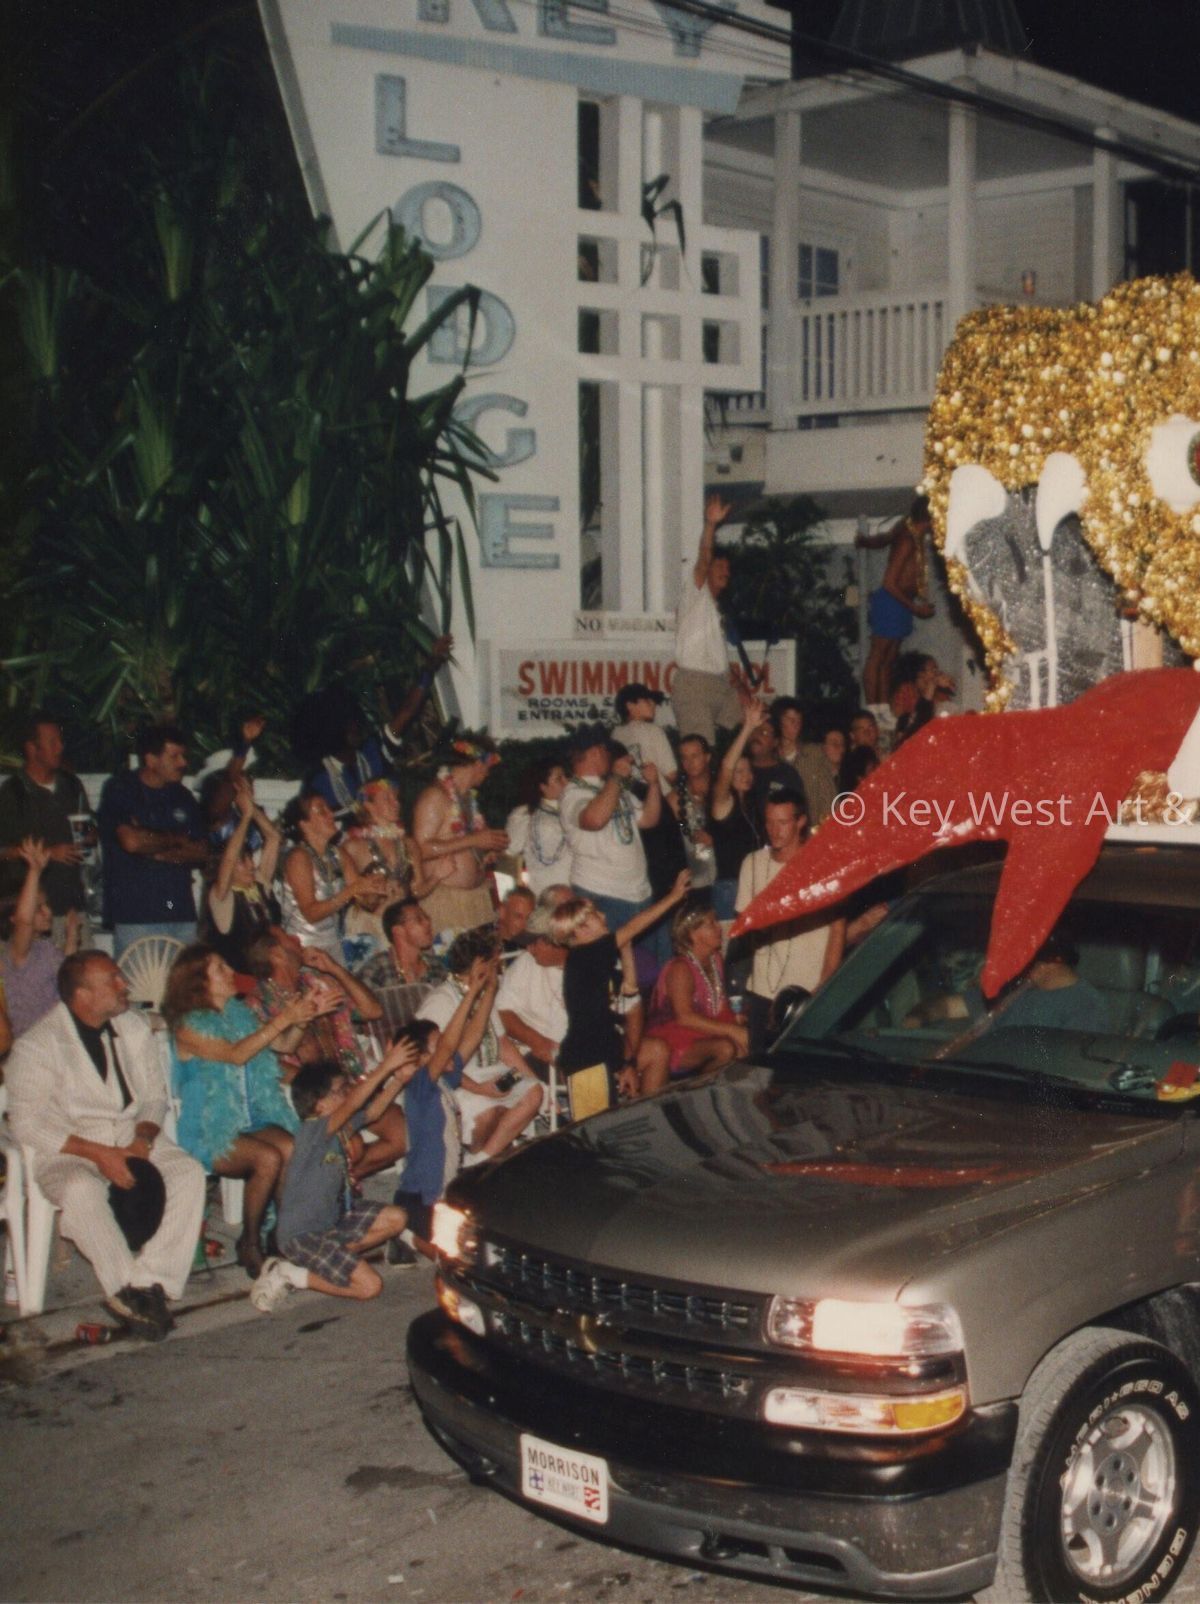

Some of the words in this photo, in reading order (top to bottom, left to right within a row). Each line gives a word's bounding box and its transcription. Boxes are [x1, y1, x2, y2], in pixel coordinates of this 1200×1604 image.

[375, 74, 560, 569] LODGE
[575, 617, 602, 632] NO
[518, 709, 609, 721] ENTRANE
[528, 697, 589, 709] ROOMS
[528, 1447, 600, 1486] MORRISON
[1078, 1528, 1187, 1604] GENE
